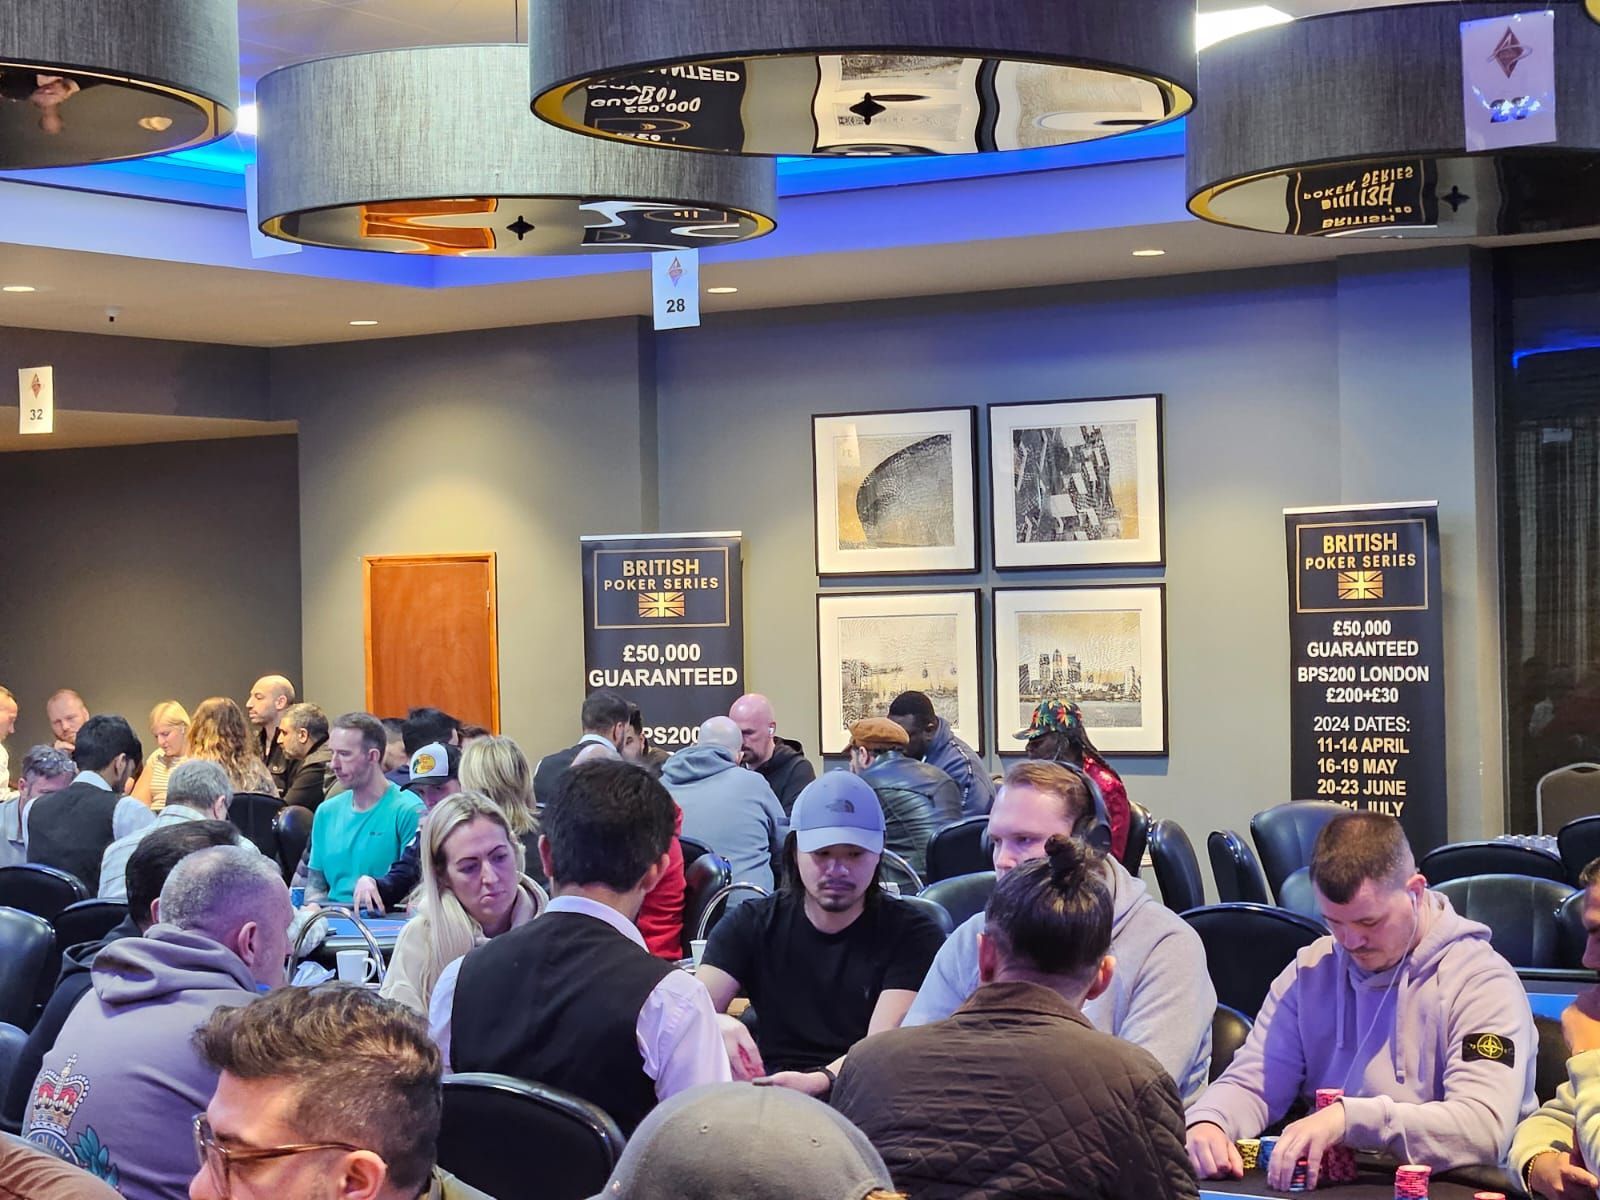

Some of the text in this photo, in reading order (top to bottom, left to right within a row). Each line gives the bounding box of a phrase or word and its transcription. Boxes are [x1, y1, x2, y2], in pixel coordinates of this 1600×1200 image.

[666, 298, 686, 313] 28
[30, 409, 43, 420] 32
[1323, 533, 1398, 553] BRITISH
[623, 559, 699, 577] BRITISH
[1305, 554, 1416, 570] POKER SERIES
[604, 577, 719, 591] POKER SERIES
[1332, 620, 1392, 639] £50,000
[622, 643, 701, 665] £50,000
[1307, 641, 1419, 657] GUARANTEED
[589, 667, 738, 687] GUARANTEED
[1298, 666, 1430, 682] BPS200 LONDON
[1326, 687, 1399, 703] £200+£30
[1314, 716, 1411, 732] 2024 DATES:
[641, 726, 701, 745] PS200
[1317, 737, 1410, 754] 11-14 APRIL
[1317, 758, 1398, 774] 16-19 MAY
[1317, 779, 1407, 796] 20-23 JUNE
[1367, 800, 1404, 817] JULY
